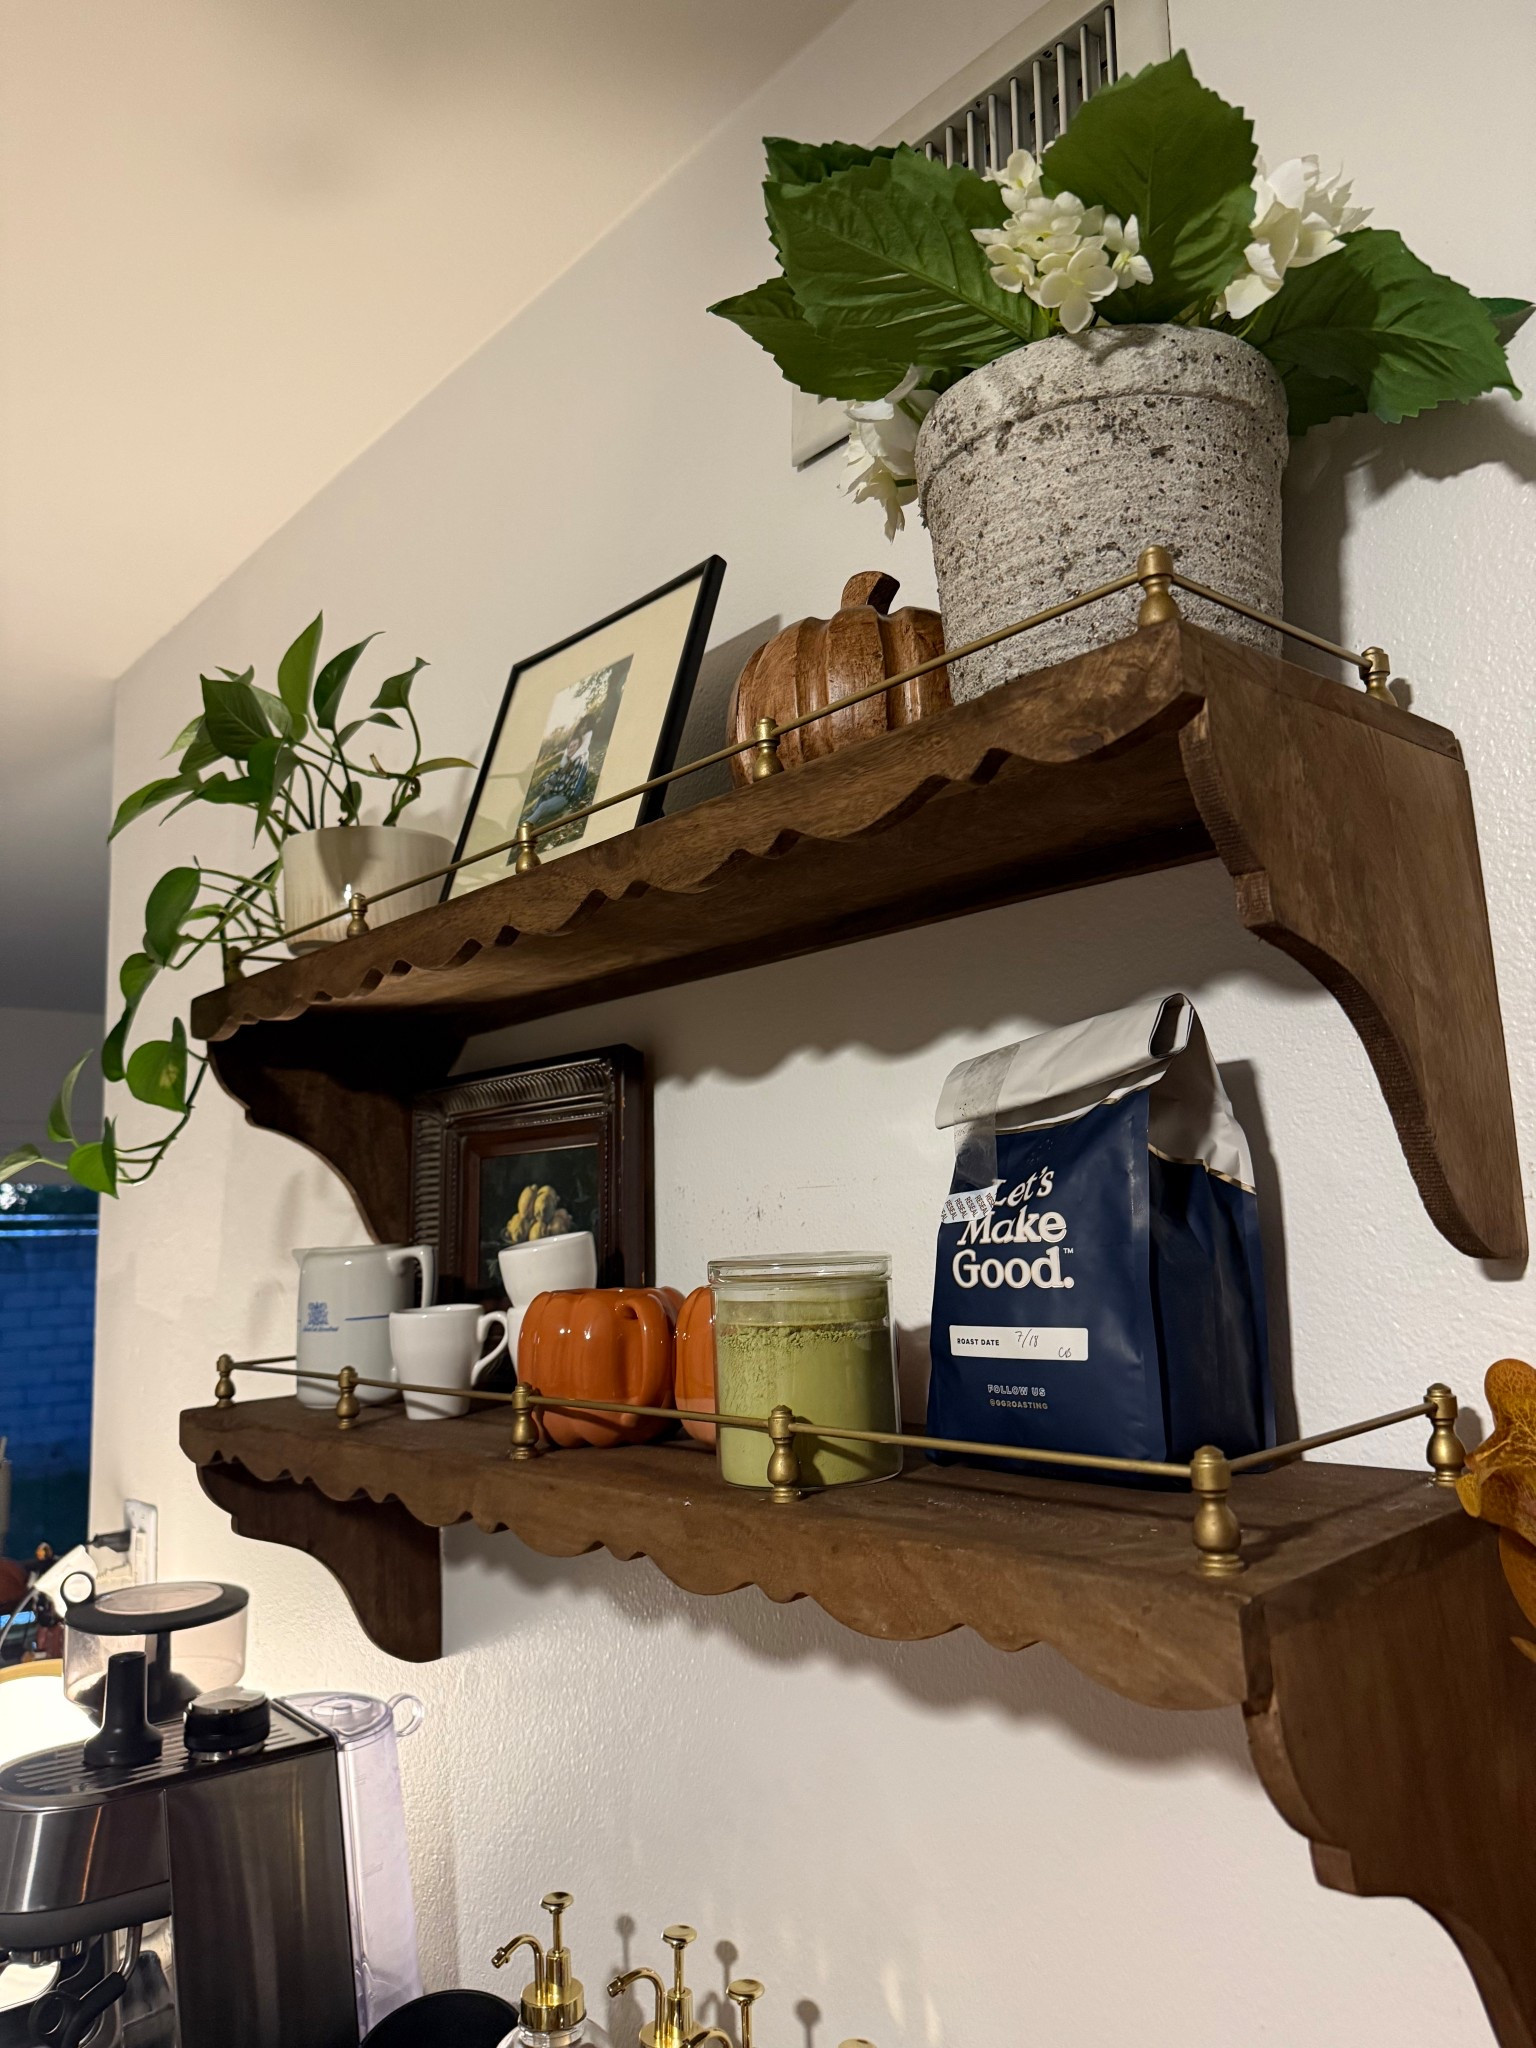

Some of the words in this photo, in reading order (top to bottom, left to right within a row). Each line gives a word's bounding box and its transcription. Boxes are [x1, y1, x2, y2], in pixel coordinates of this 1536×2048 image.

[991, 1165, 1055, 1207] Let's
[945, 1199, 958, 1220] RESEAL
[955, 1197, 968, 1219] RESEAL
[965, 1196, 978, 1218] RESEAL
[975, 1194, 989, 1216] RESEAL
[956, 1204, 1067, 1246] Make
[952, 1246, 1075, 1289] Good.
[956, 1338, 979, 1346] ROAST
[1015, 1328, 1039, 1348] 7/18
[987, 1384, 1029, 1396] FOLLOW
[1031, 1387, 1046, 1397] US
